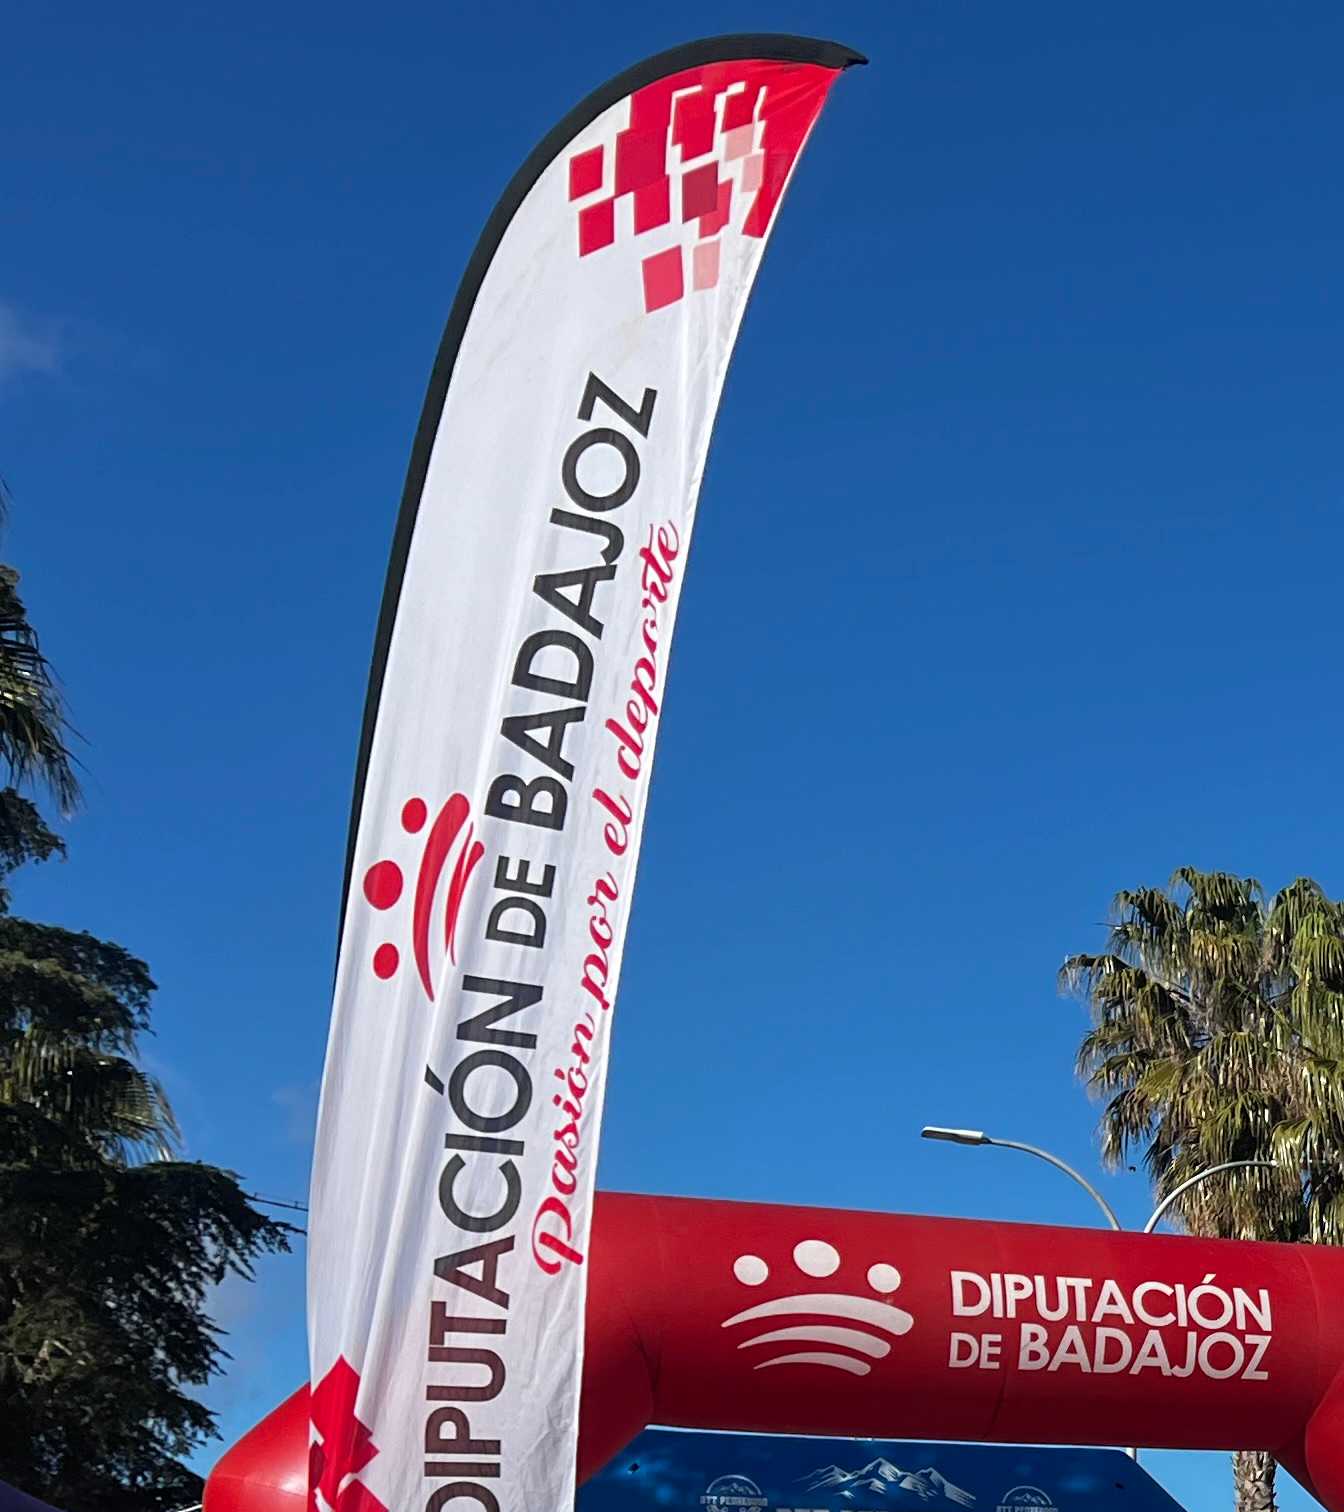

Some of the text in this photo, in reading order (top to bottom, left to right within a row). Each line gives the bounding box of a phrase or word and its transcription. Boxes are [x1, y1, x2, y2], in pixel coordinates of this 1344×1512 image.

[485, 370, 658, 832] BADAJOZ
[485, 855, 557, 949] DE
[531, 518, 681, 1276] Pasión por el deporte
[950, 1270, 1272, 1332] DIPUTACIÓN
[948, 1323, 1272, 1382] DE BADAJOZ
